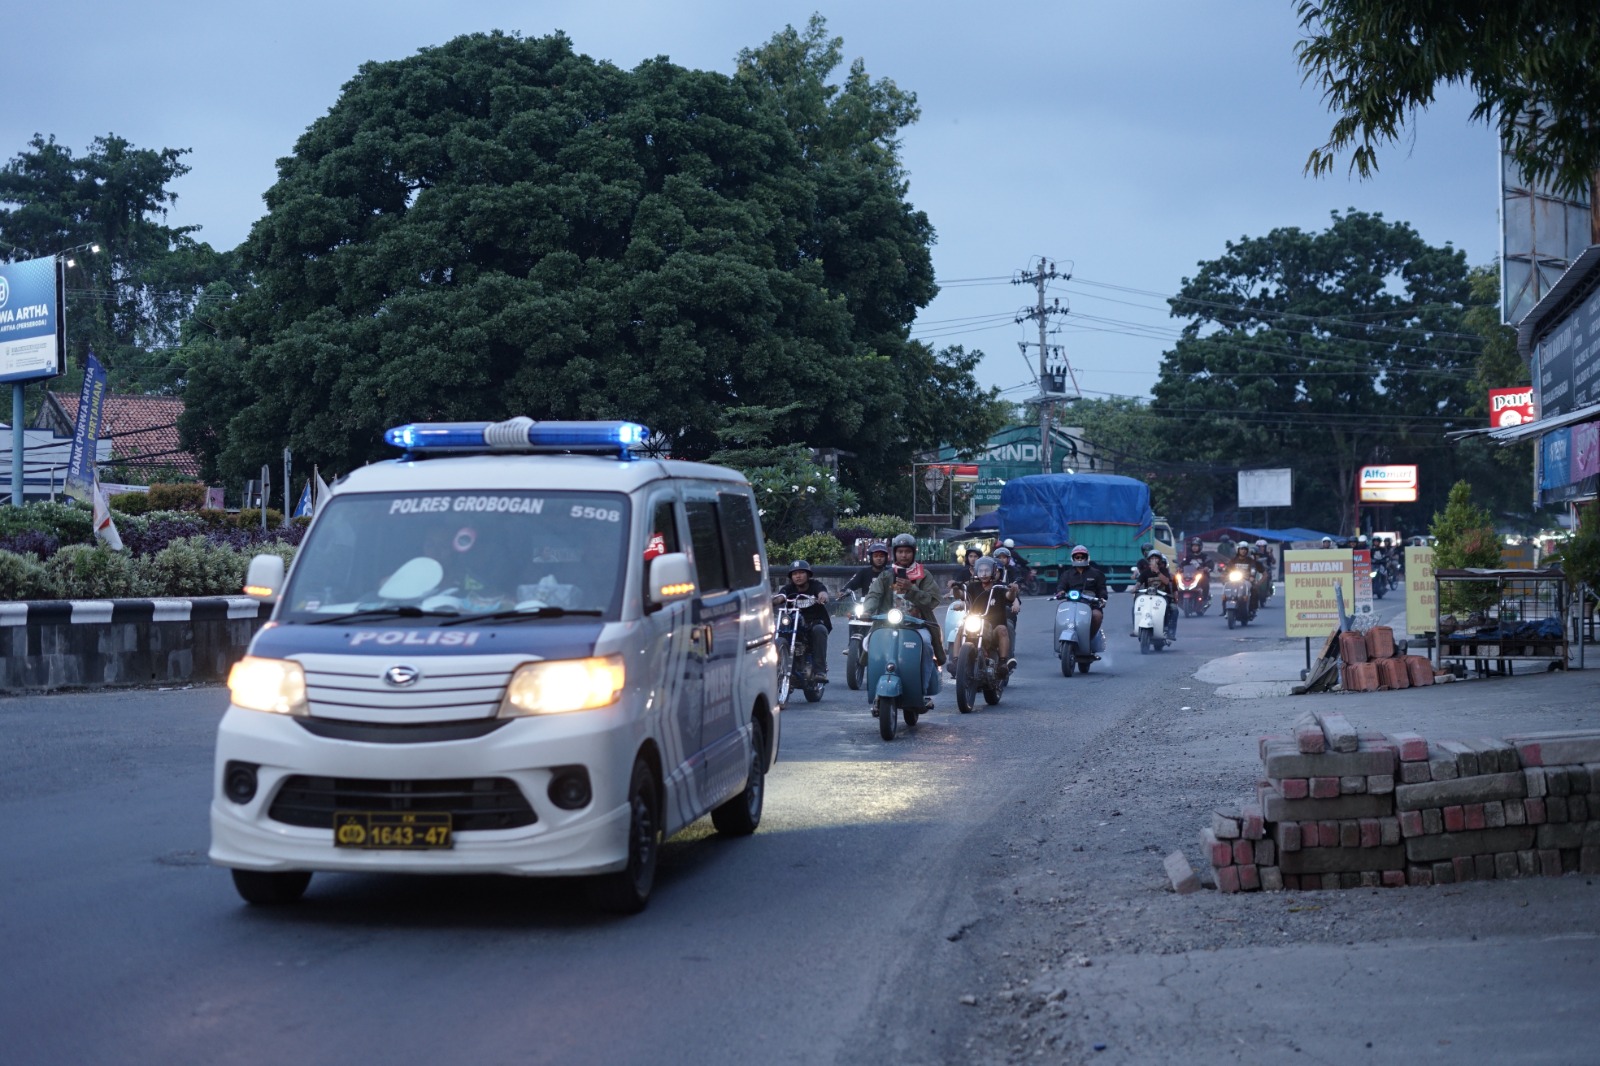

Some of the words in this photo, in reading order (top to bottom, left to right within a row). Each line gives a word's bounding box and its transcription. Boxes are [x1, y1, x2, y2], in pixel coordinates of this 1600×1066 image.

[16, 303, 48, 320] ARTHA
[82, 367, 95, 404] ARTHA
[88, 381, 103, 440] PERTANIAN
[75, 405, 89, 444] PURWA
[71, 445, 83, 476] BANK
[389, 497, 450, 514] POLRES
[453, 497, 544, 514] GROBOGAN
[570, 505, 620, 522] 5508
[1290, 561, 1343, 573] MELAYANI
[1316, 590, 1323, 598] &
[1289, 599, 1350, 610] PEMASANGN
[350, 630, 480, 646] POLISI
[371, 826, 448, 845] 1643-47
